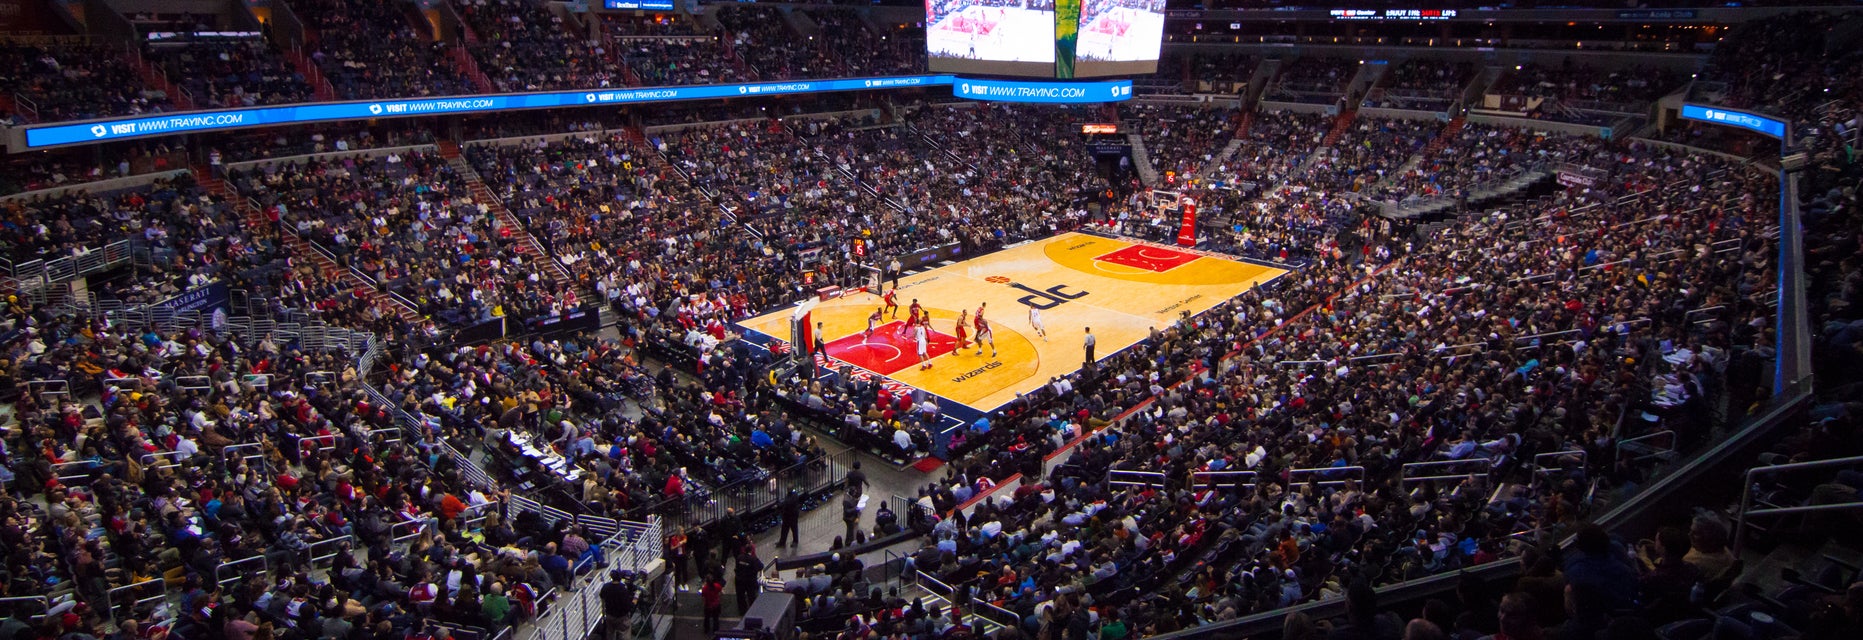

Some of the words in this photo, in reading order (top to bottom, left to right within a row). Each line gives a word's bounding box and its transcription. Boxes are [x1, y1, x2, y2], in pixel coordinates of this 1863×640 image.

[598, 93, 614, 101] VISIT
[615, 90, 678, 100] WWW.TRAYINC.COM
[971, 85, 988, 95] VISIT
[989, 86, 1086, 98] WWW.TRAYINC.COM
[386, 104, 407, 113] VISIT
[409, 99, 494, 111] WWW.TRAYINC.COM
[111, 122, 137, 135] VISIT
[138, 114, 243, 132] WWW.TRAYINC.COM
[164, 288, 210, 310] MASERATI
[951, 359, 1003, 384] wizards
